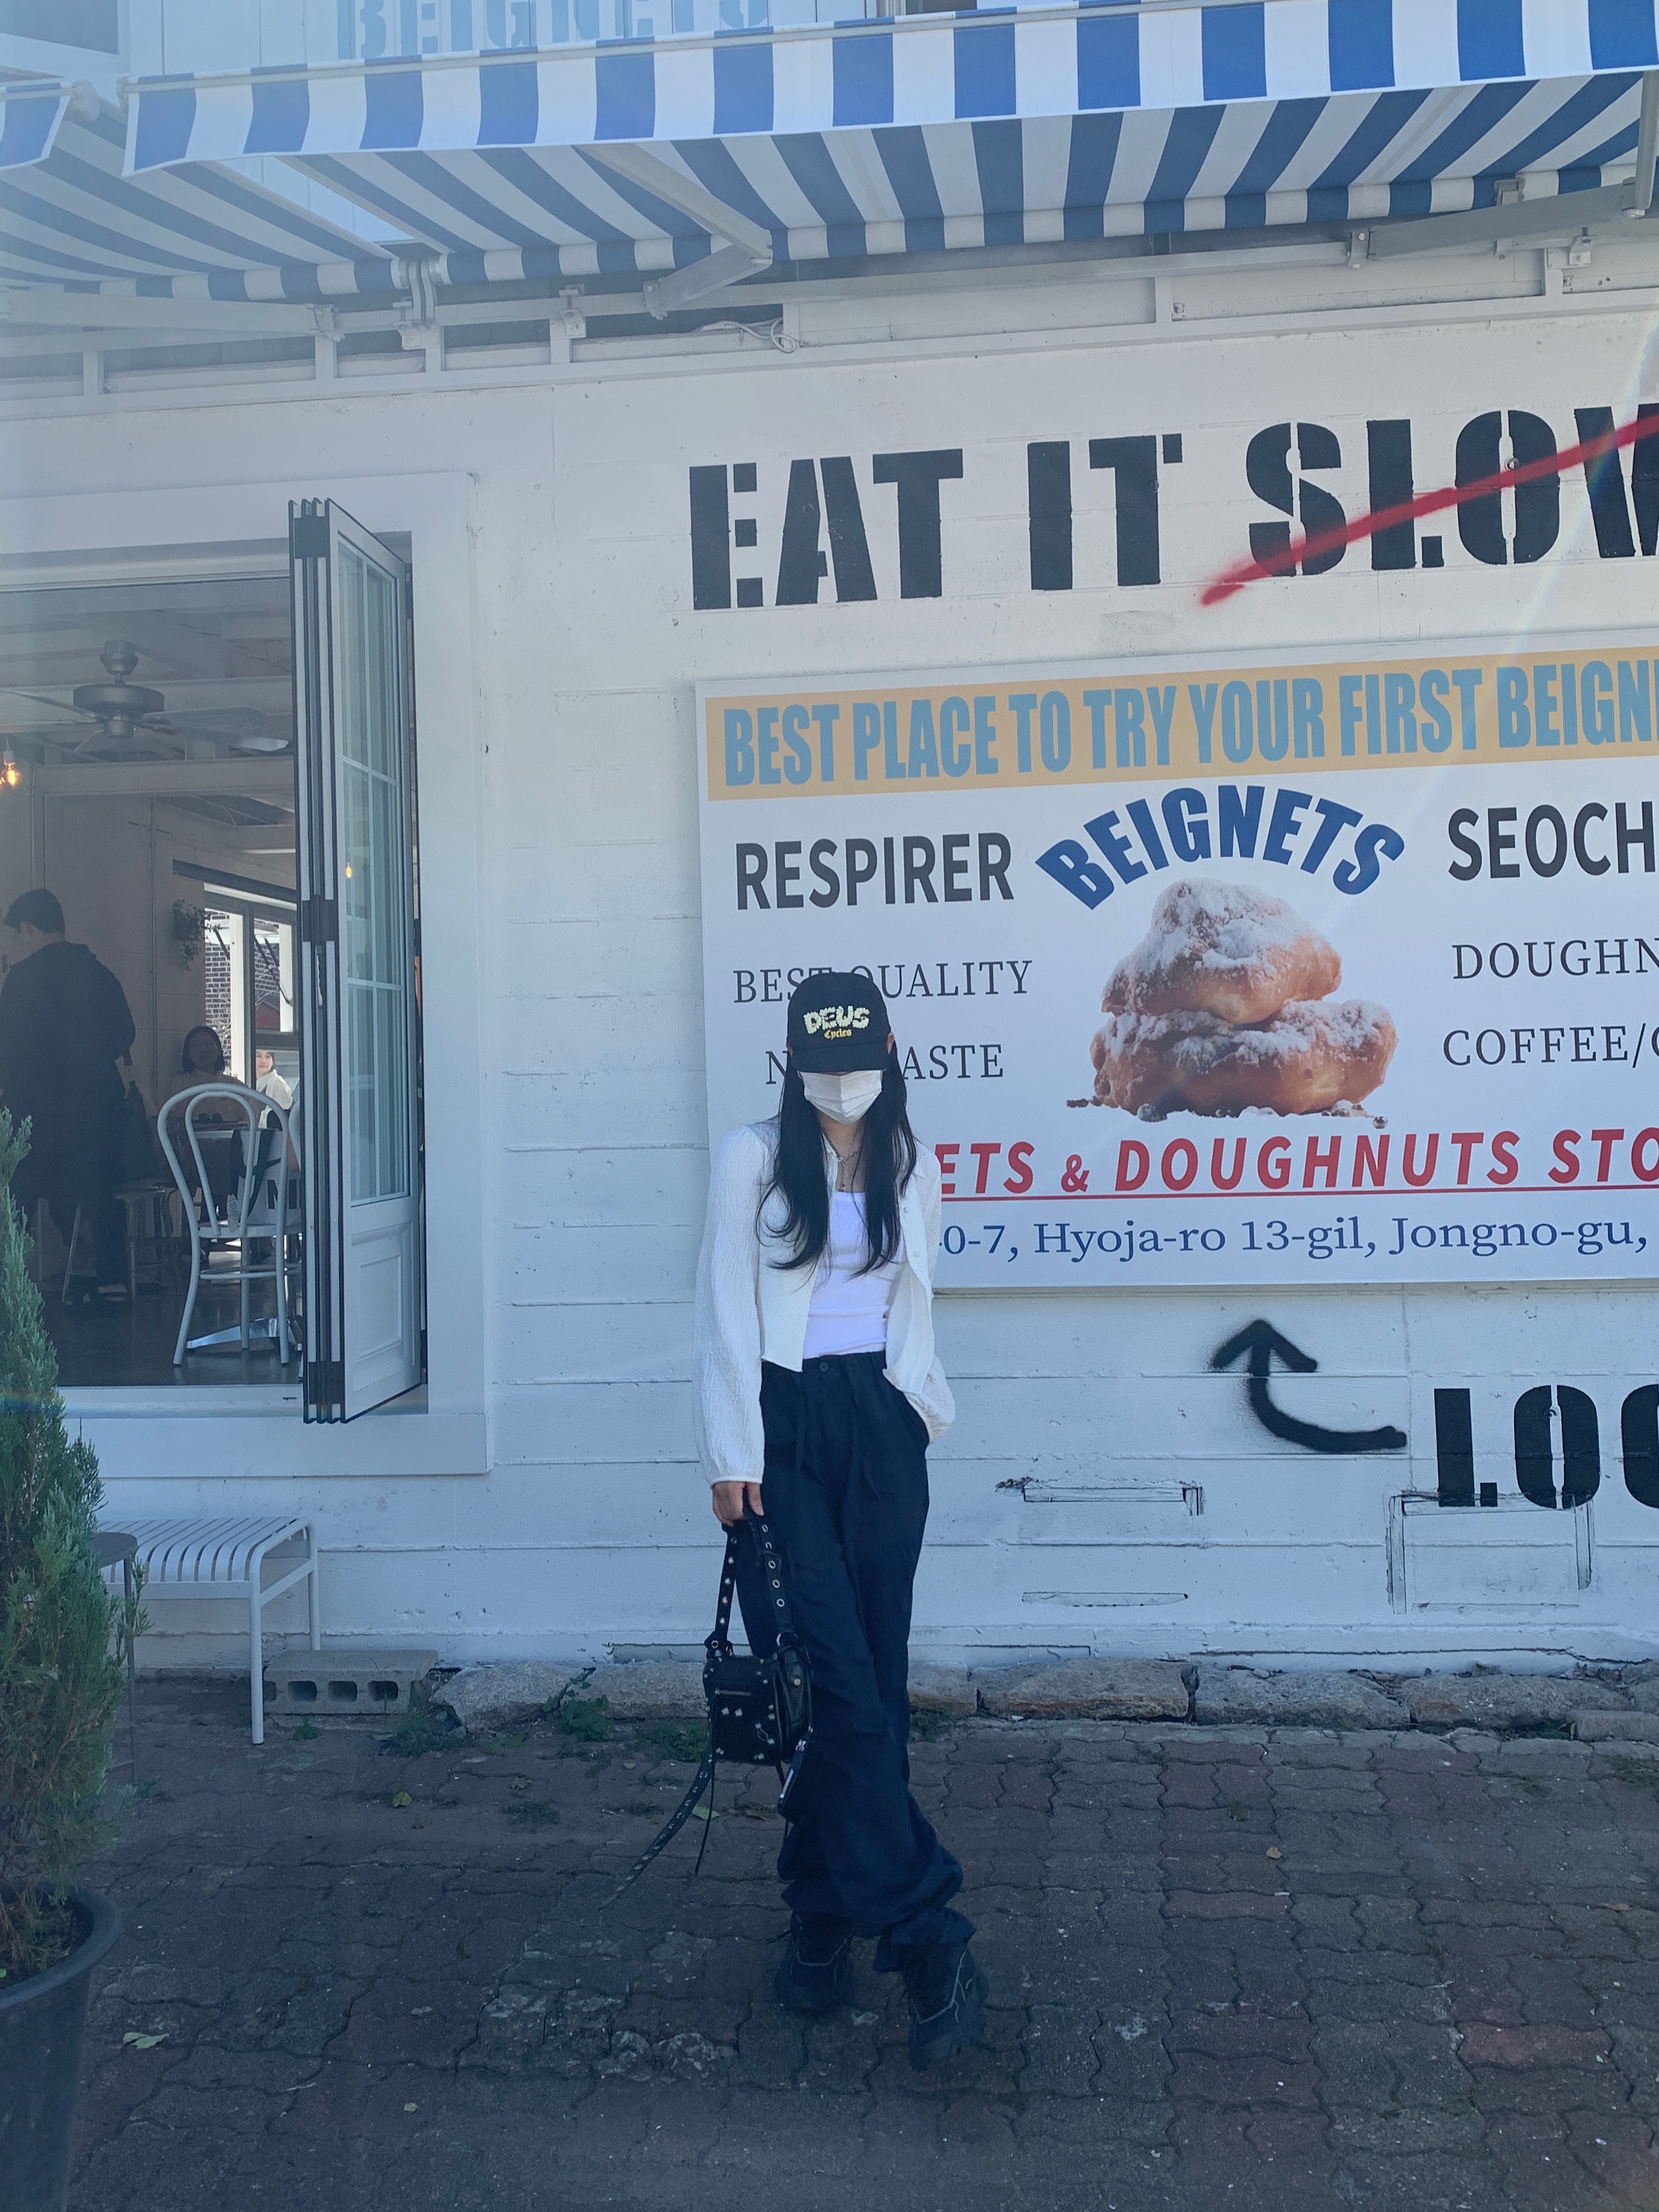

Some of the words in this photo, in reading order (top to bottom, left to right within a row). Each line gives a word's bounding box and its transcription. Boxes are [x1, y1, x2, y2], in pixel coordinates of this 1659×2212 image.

[690, 448, 964, 610] EAT
[1027, 433, 1183, 591] IT
[724, 704, 840, 786] BEST
[853, 696, 999, 781] PLACE
[1009, 690, 1072, 773] TO
[1083, 685, 1177, 770] TRY
[1188, 678, 1325, 764] YOUR
[1339, 668, 1482, 756] FIRST
[1496, 659, 1659, 748] BEIGN
[1035, 785, 1405, 910] BEIGNETS
[736, 833, 1014, 910] RESPIRER
[733, 967, 833, 1003] BES
[803, 1006, 870, 1034] DEUS
[824, 1029, 852, 1040] Cycles
[903, 1044, 1003, 1080] ASTE
[1443, 1023, 1659, 1068] COFFEE/
[1061, 1154, 1090, 1193] &
[1115, 1130, 1520, 1191] DOUGHNUTS
[939, 1225, 1019, 1263] 0-7,
[1034, 1220, 1226, 1263] Hyoja-ro
[1241, 1216, 1376, 1259] 13-gil,
[1389, 1218, 1647, 1256] Jongno-gu,
